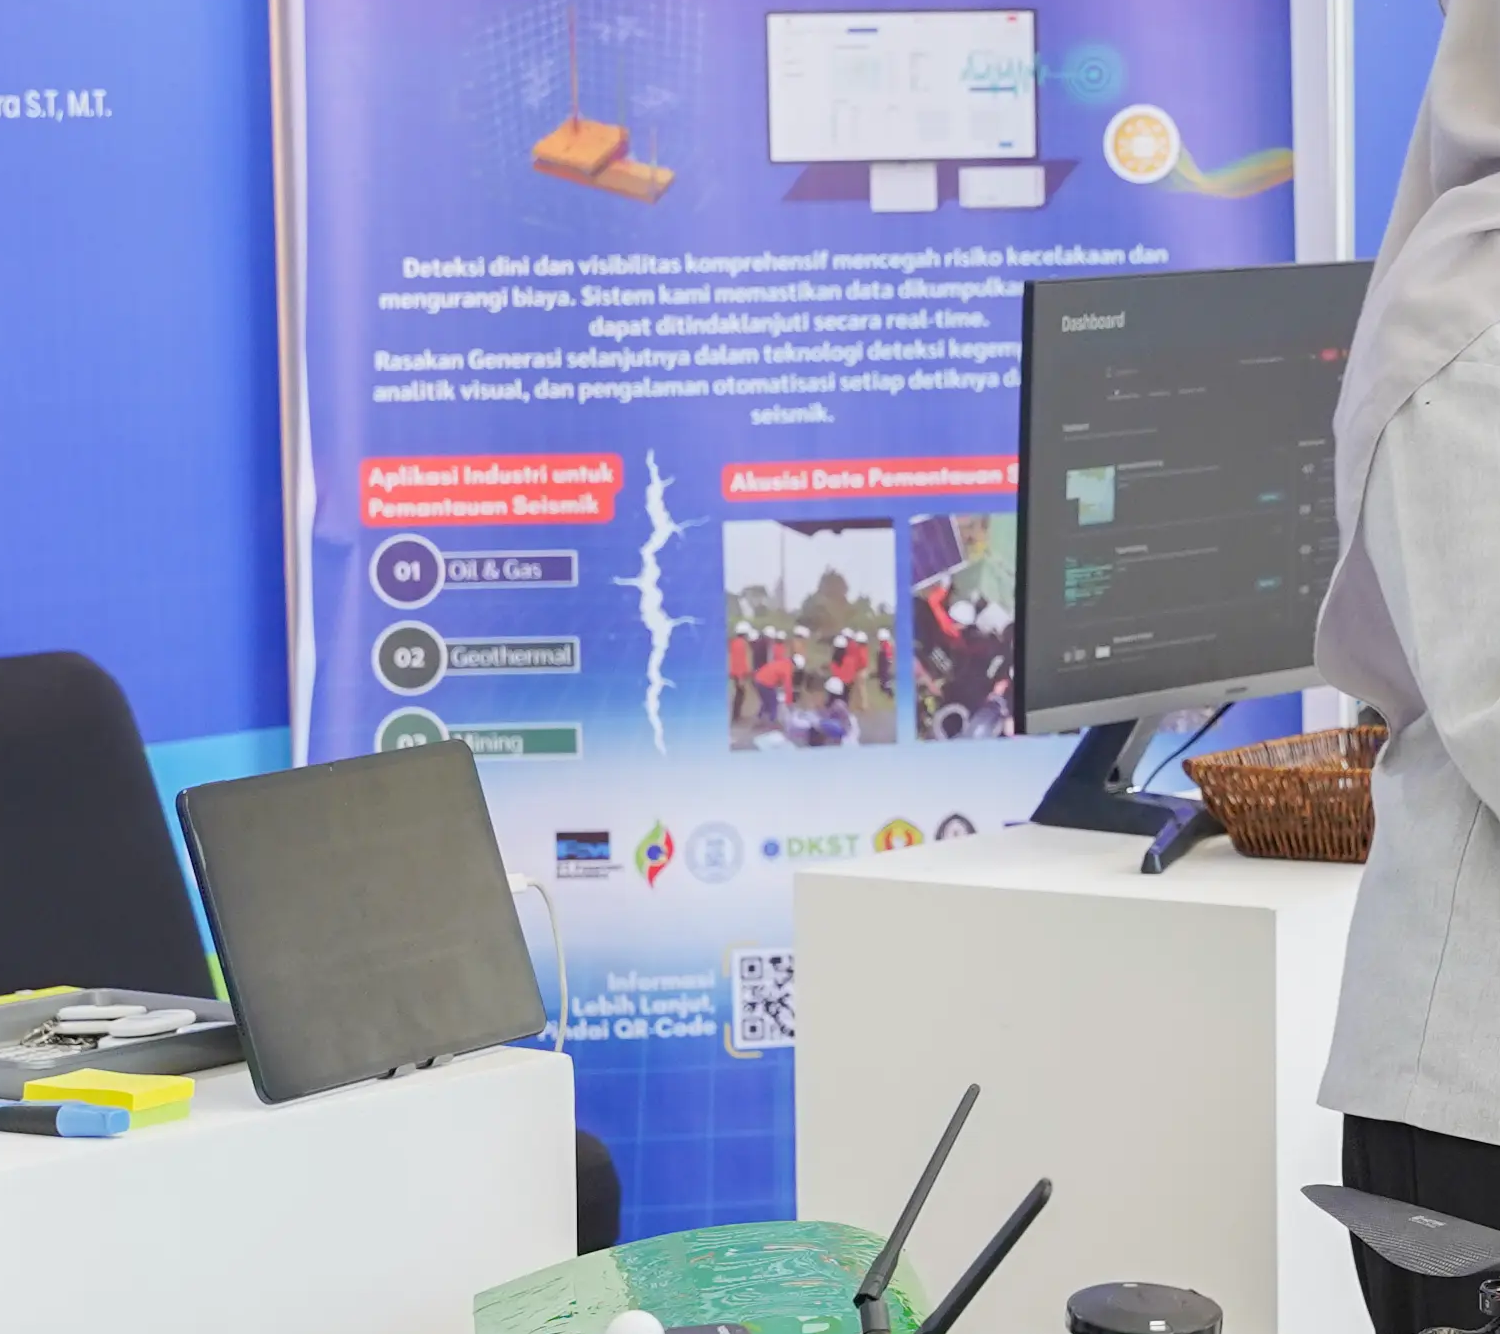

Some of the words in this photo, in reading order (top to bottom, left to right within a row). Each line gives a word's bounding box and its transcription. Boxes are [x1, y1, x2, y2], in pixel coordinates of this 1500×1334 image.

[67, 88, 112, 119] M.T.
[402, 255, 485, 279] Deteksi
[488, 254, 530, 277] dini
[533, 254, 574, 277] dan
[577, 253, 681, 276] visibilitas
[684, 248, 829, 279] komprehensif
[832, 247, 941, 274] mencegah
[944, 246, 1003, 267] risiko
[1006, 244, 1125, 268] kecelakaan
[1129, 244, 1169, 265] dan
[378, 286, 508, 314] mengurangi
[511, 286, 576, 311] biaya.
[580, 284, 655, 308] Sistem
[658, 283, 711, 305] kami
[713, 279, 843, 304] memastikan
[845, 279, 894, 301] data
[588, 315, 651, 343] dapat
[655, 311, 810, 338] ditindaklanjuti
[813, 314, 882, 332] secara
[885, 308, 991, 330] real-time.
[1061, 311, 1126, 334] Dashboard
[373, 349, 464, 372] Rasakan
[467, 346, 563, 370] Generasi
[565, 346, 691, 373] selanjutnya
[694, 343, 759, 366] dalam
[763, 340, 864, 367] teknologi
[867, 338, 945, 361] deteksi
[372, 378, 456, 403] analitik
[459, 377, 530, 404] visual,
[534, 377, 574, 400] dan
[577, 375, 709, 405] pengalaman
[711, 371, 836, 396] otomatisasi
[839, 369, 905, 396] setiap
[908, 367, 1000, 393] detiknya
[749, 402, 836, 425] seismik.
[369, 465, 459, 492] Aplikasi
[463, 464, 548, 486] Industri
[551, 462, 614, 485] untuk
[731, 471, 808, 492] Akusisi
[812, 470, 864, 489] Data
[868, 467, 1003, 488] Pemantauan
[368, 497, 508, 519] Pemantauan
[511, 493, 599, 516] Seismik
[393, 560, 422, 583] 01
[448, 559, 479, 582] Oil
[482, 560, 500, 581] &
[502, 558, 542, 580] Gas
[393, 646, 426, 669] 02
[450, 644, 572, 668] Geothermal
[786, 835, 860, 858] DKST
[607, 971, 716, 992] Informasi
[572, 995, 635, 1017] Lebih
[638, 994, 716, 1020] Lanjut,
